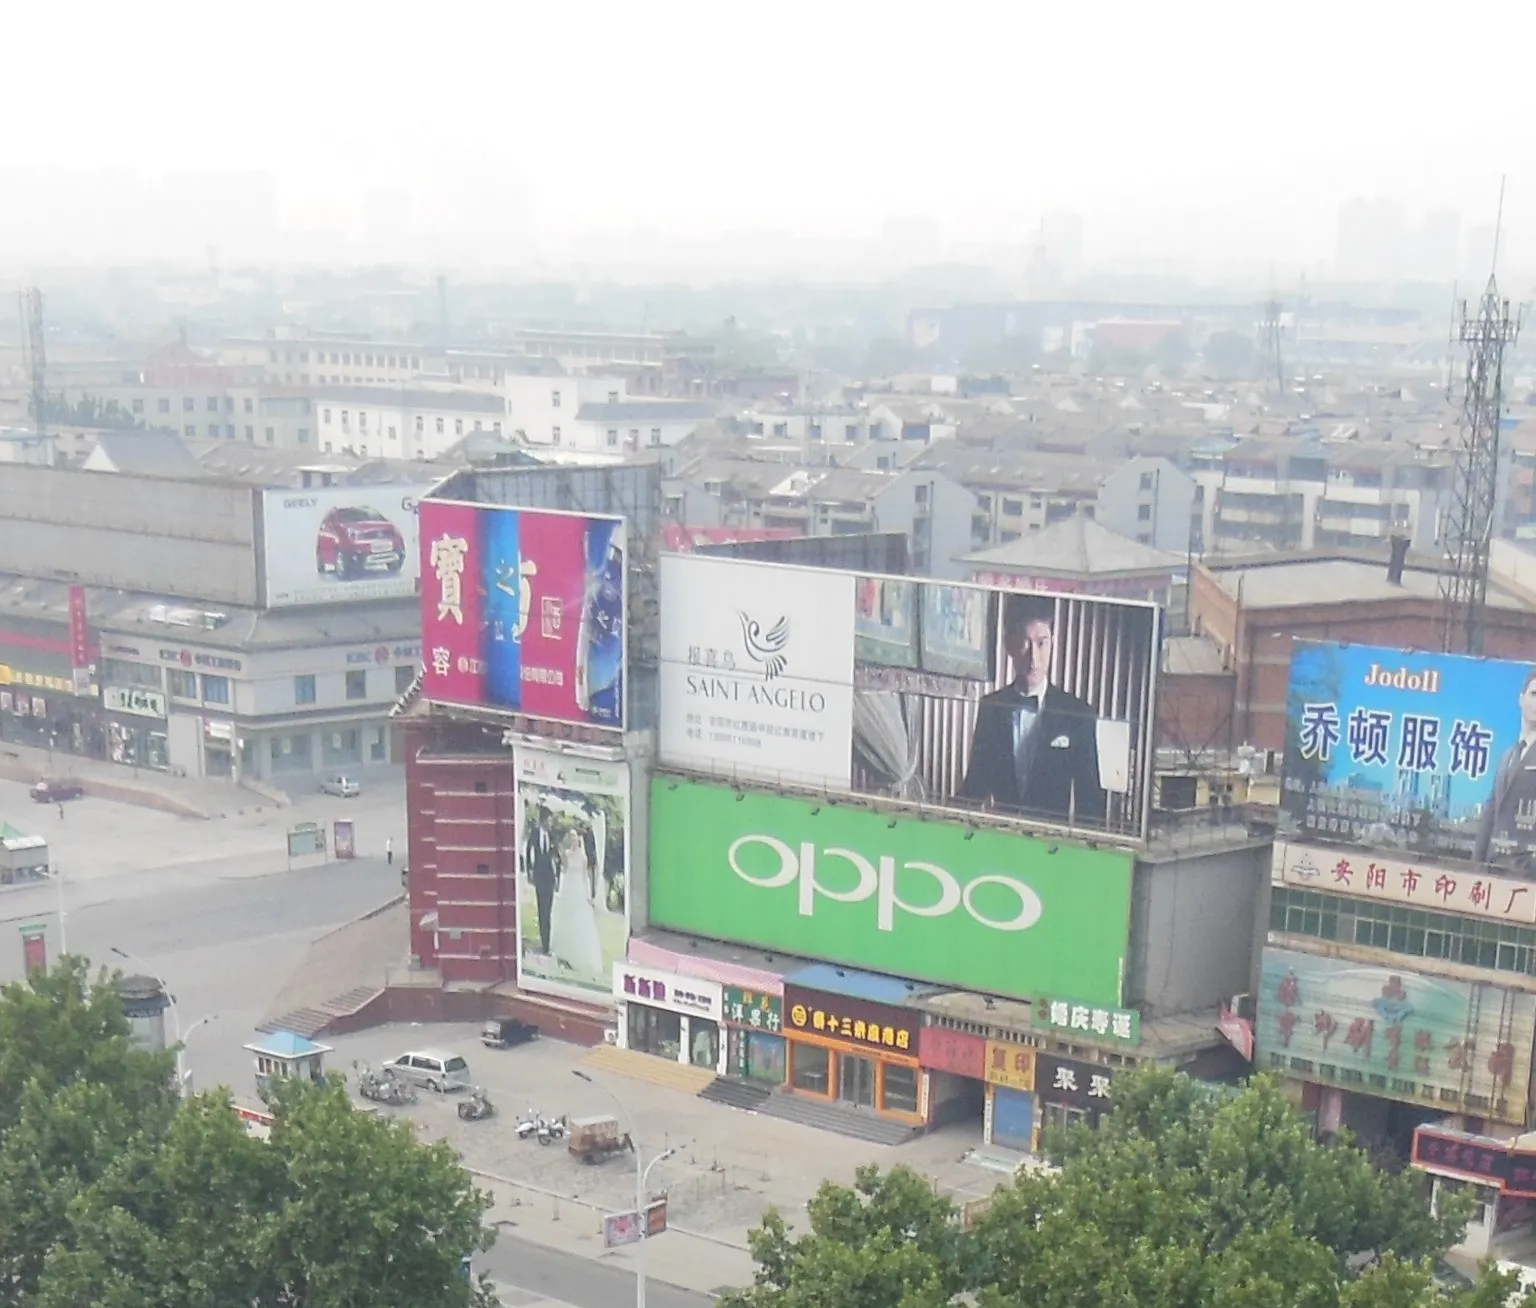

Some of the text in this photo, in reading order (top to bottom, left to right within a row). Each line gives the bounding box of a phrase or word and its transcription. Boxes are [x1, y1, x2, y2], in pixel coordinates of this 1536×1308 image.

[687, 675, 826, 713] SAINT ANGELO
[1364, 664, 1441, 692] Jodoll
[1300, 702, 1493, 781] 乔顿服饰
[1331, 859, 1528, 913] 安阳市印刷厂
